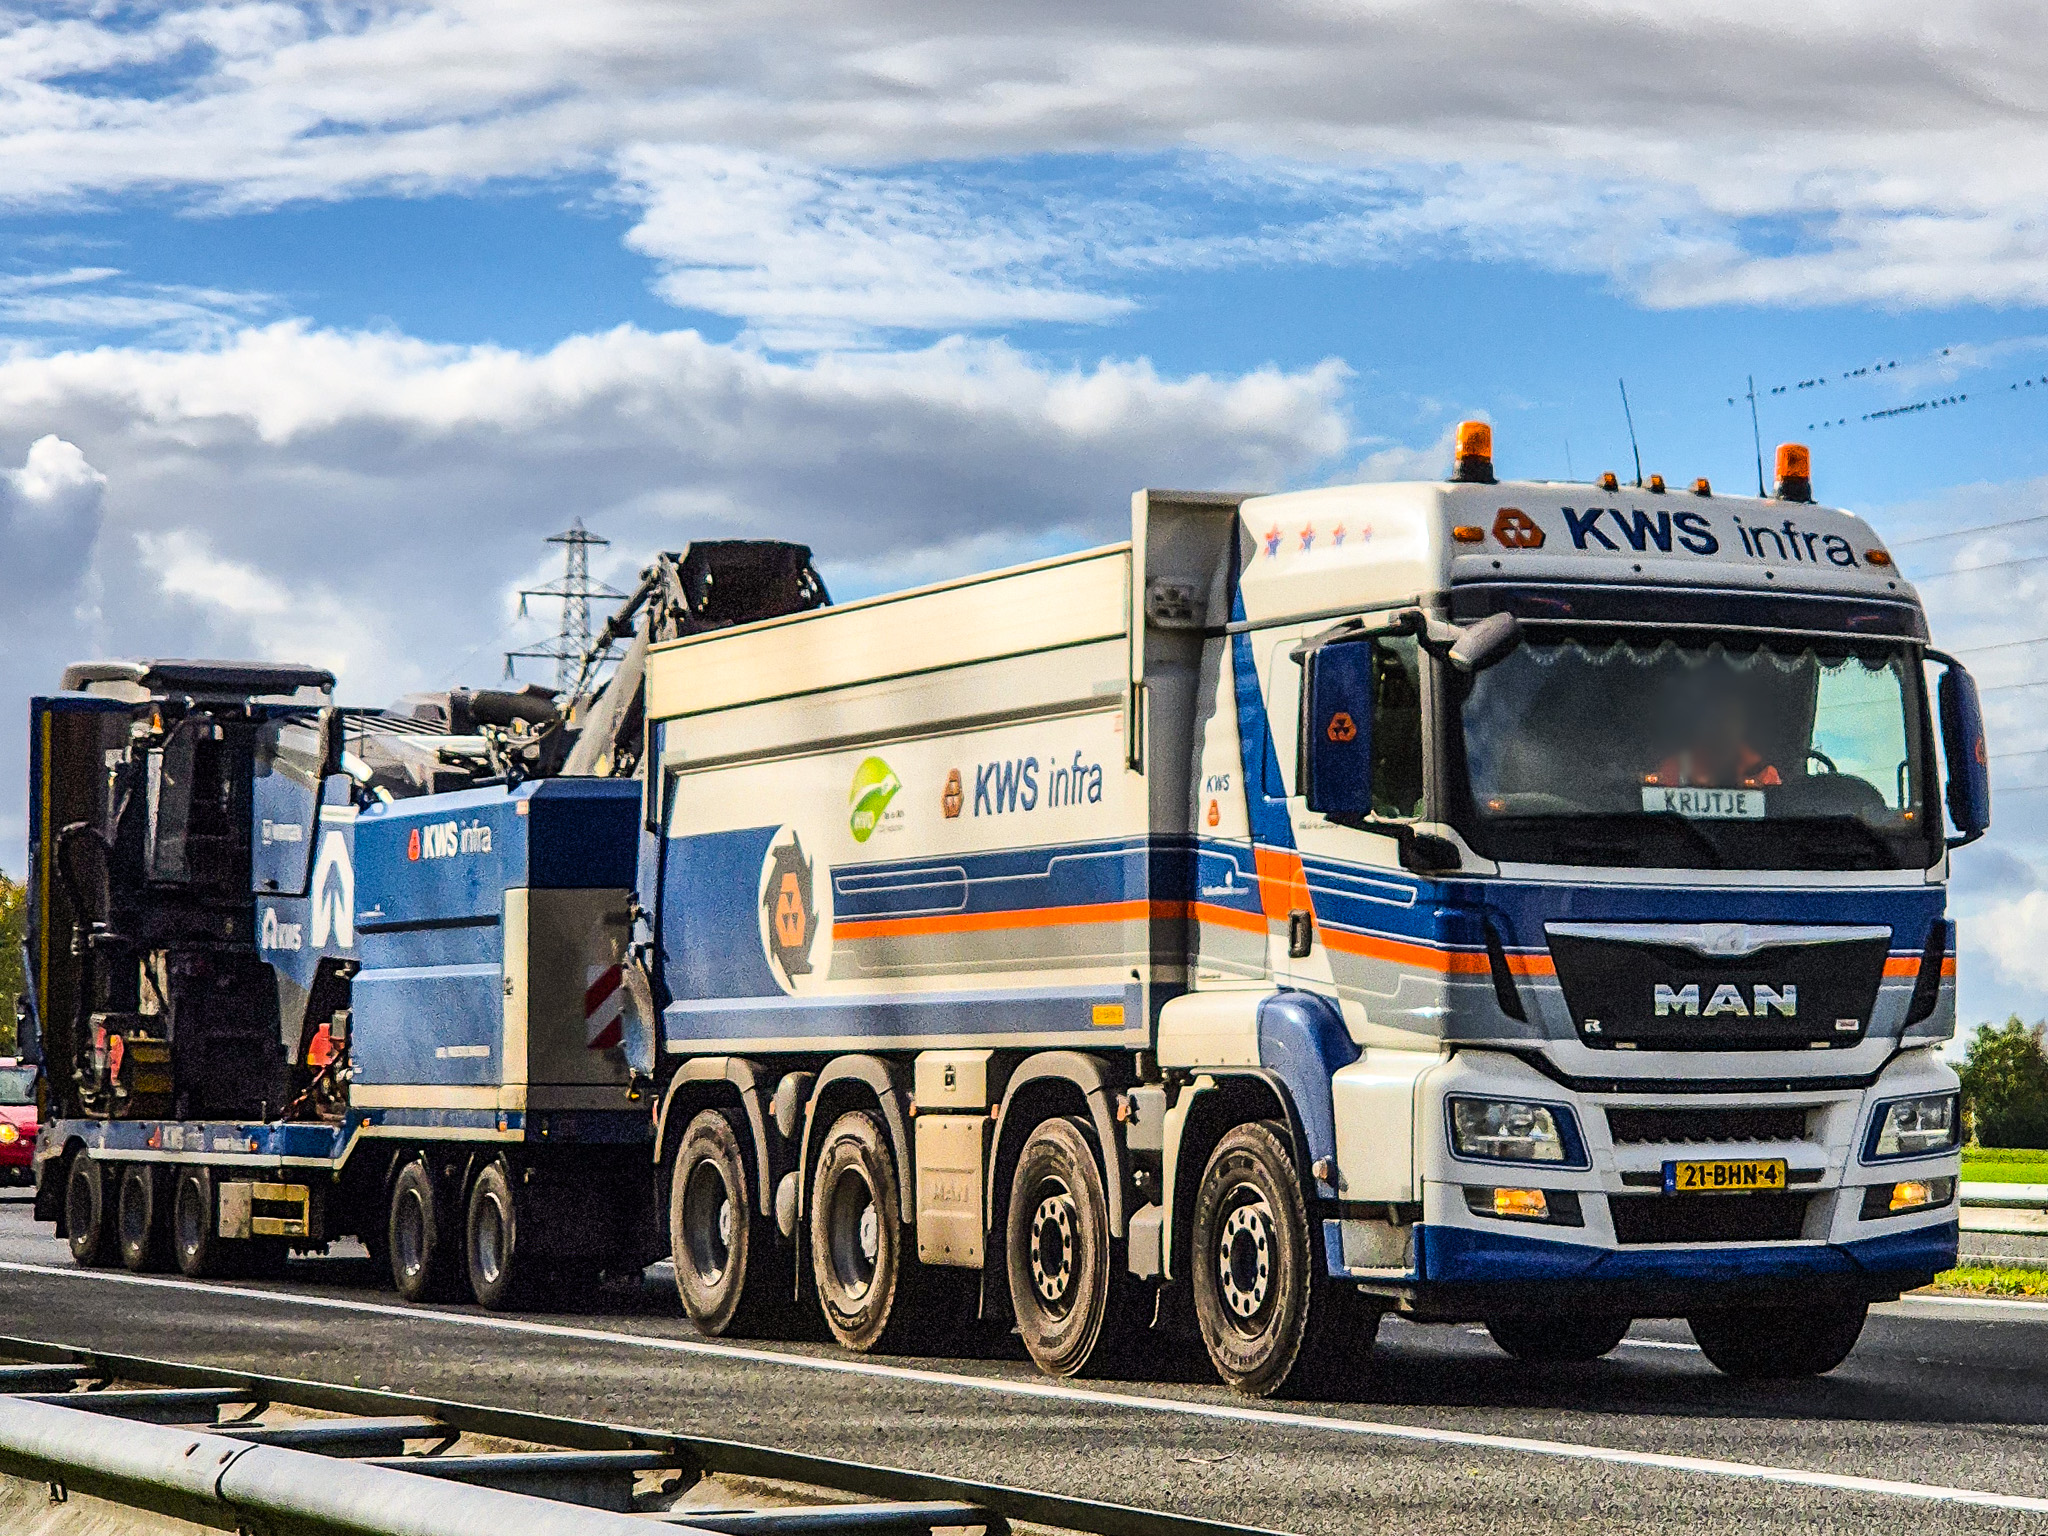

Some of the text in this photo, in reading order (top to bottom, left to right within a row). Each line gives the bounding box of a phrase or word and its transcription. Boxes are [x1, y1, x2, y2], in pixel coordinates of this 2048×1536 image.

[1562, 507, 1860, 568] KWS infra
[974, 750, 1102, 817] KWS infra
[1206, 774, 1230, 792] KWS
[1664, 791, 1748, 815] KRIJTJE
[423, 819, 492, 859] KWS infra
[1654, 984, 1797, 1016] MAN
[1685, 1163, 1778, 1187] 21-BHN-4
